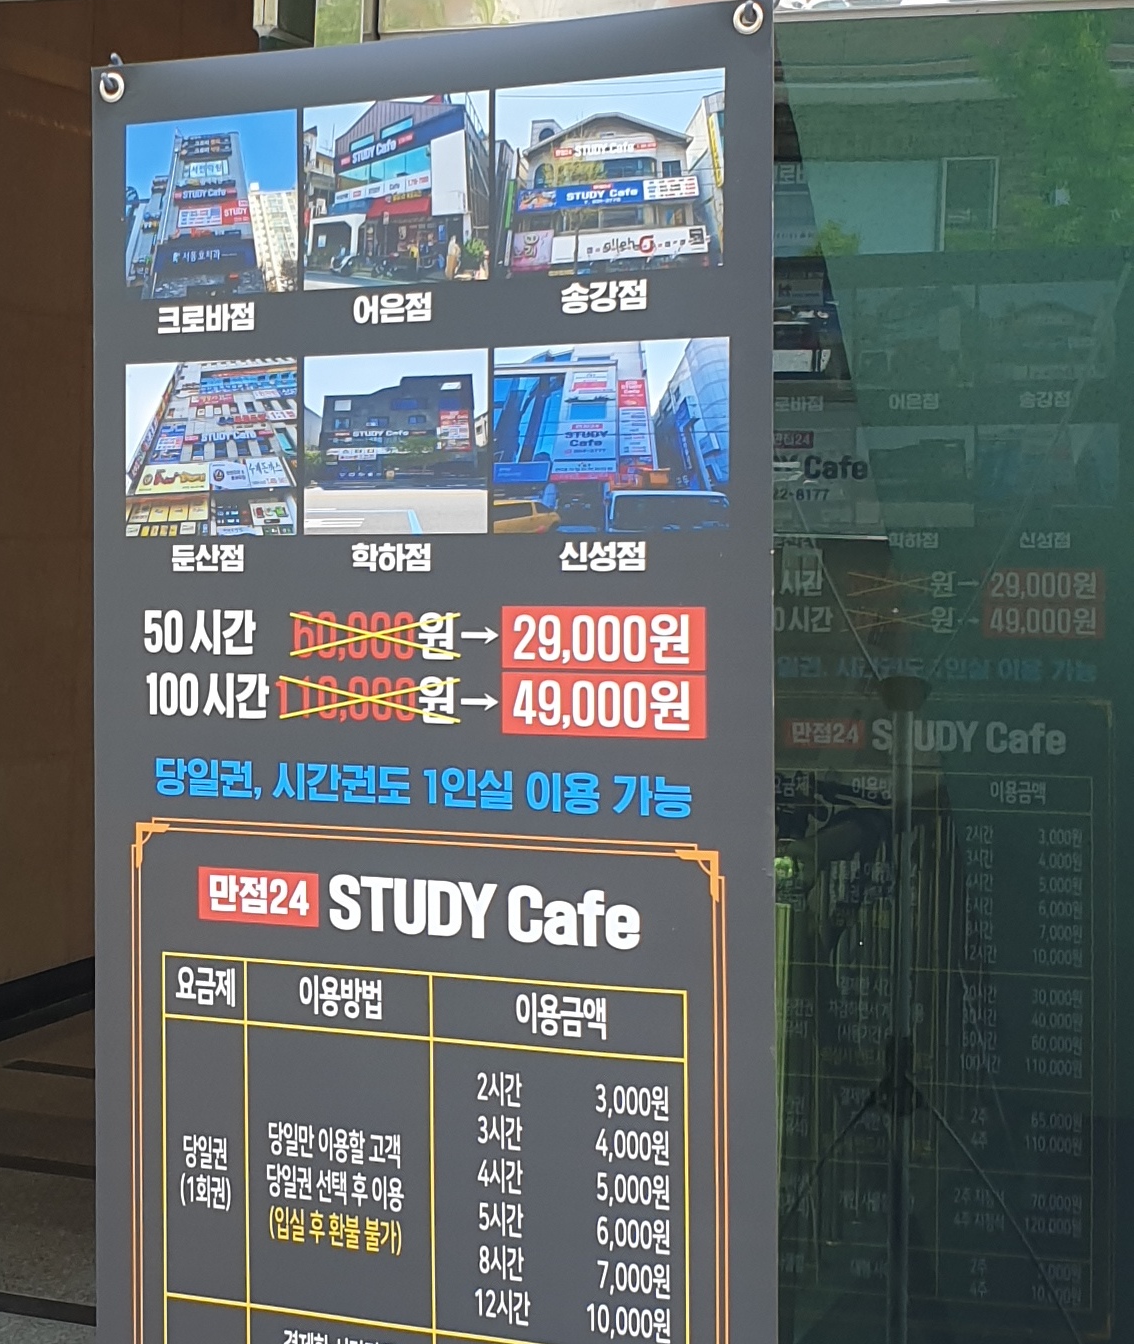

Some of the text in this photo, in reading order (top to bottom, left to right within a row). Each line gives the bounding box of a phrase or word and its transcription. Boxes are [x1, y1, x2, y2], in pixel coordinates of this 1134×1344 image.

[157, 302, 255, 335] 크로바점
[352, 292, 432, 325] 어은점
[560, 280, 648, 316] 송강점
[171, 545, 245, 573] 둔산점
[351, 542, 432, 573] 학하점
[559, 541, 646, 572] 신성점
[143, 609, 183, 654] 50
[190, 608, 255, 656] 시간
[512, 613, 690, 665] 29,000원
[146, 672, 202, 718] 100
[203, 672, 269, 719] 시간
[512, 679, 690, 731] 49,000원
[155, 756, 692, 819] 당일권, 시간권도 1인실 이용 가능
[208, 873, 641, 950] 만점24 STUDY Cafe
[176, 966, 236, 1007] 요금제
[299, 975, 383, 1020] 이용방법
[515, 992, 607, 1040] 이용금액
[477, 1072, 669, 1122] 2시간 3,000원
[182, 1135, 228, 1171] 당일권
[267, 1122, 402, 1169] 당일만 이용할 고객
[477, 1115, 669, 1167] 3시간 4,000원
[180, 1174, 231, 1211] (1회권)
[266, 1164, 405, 1213] 당일권 선택 후 이용
[477, 1160, 670, 1211] 4시간 5,000원
[268, 1206, 402, 1256] (입실 후 환불 불가)
[478, 1204, 670, 1256] 5시간 6,000원
[478, 1248, 671, 1300] 8시간 7,000원
[475, 1290, 671, 1344] 12시간 10,000원
